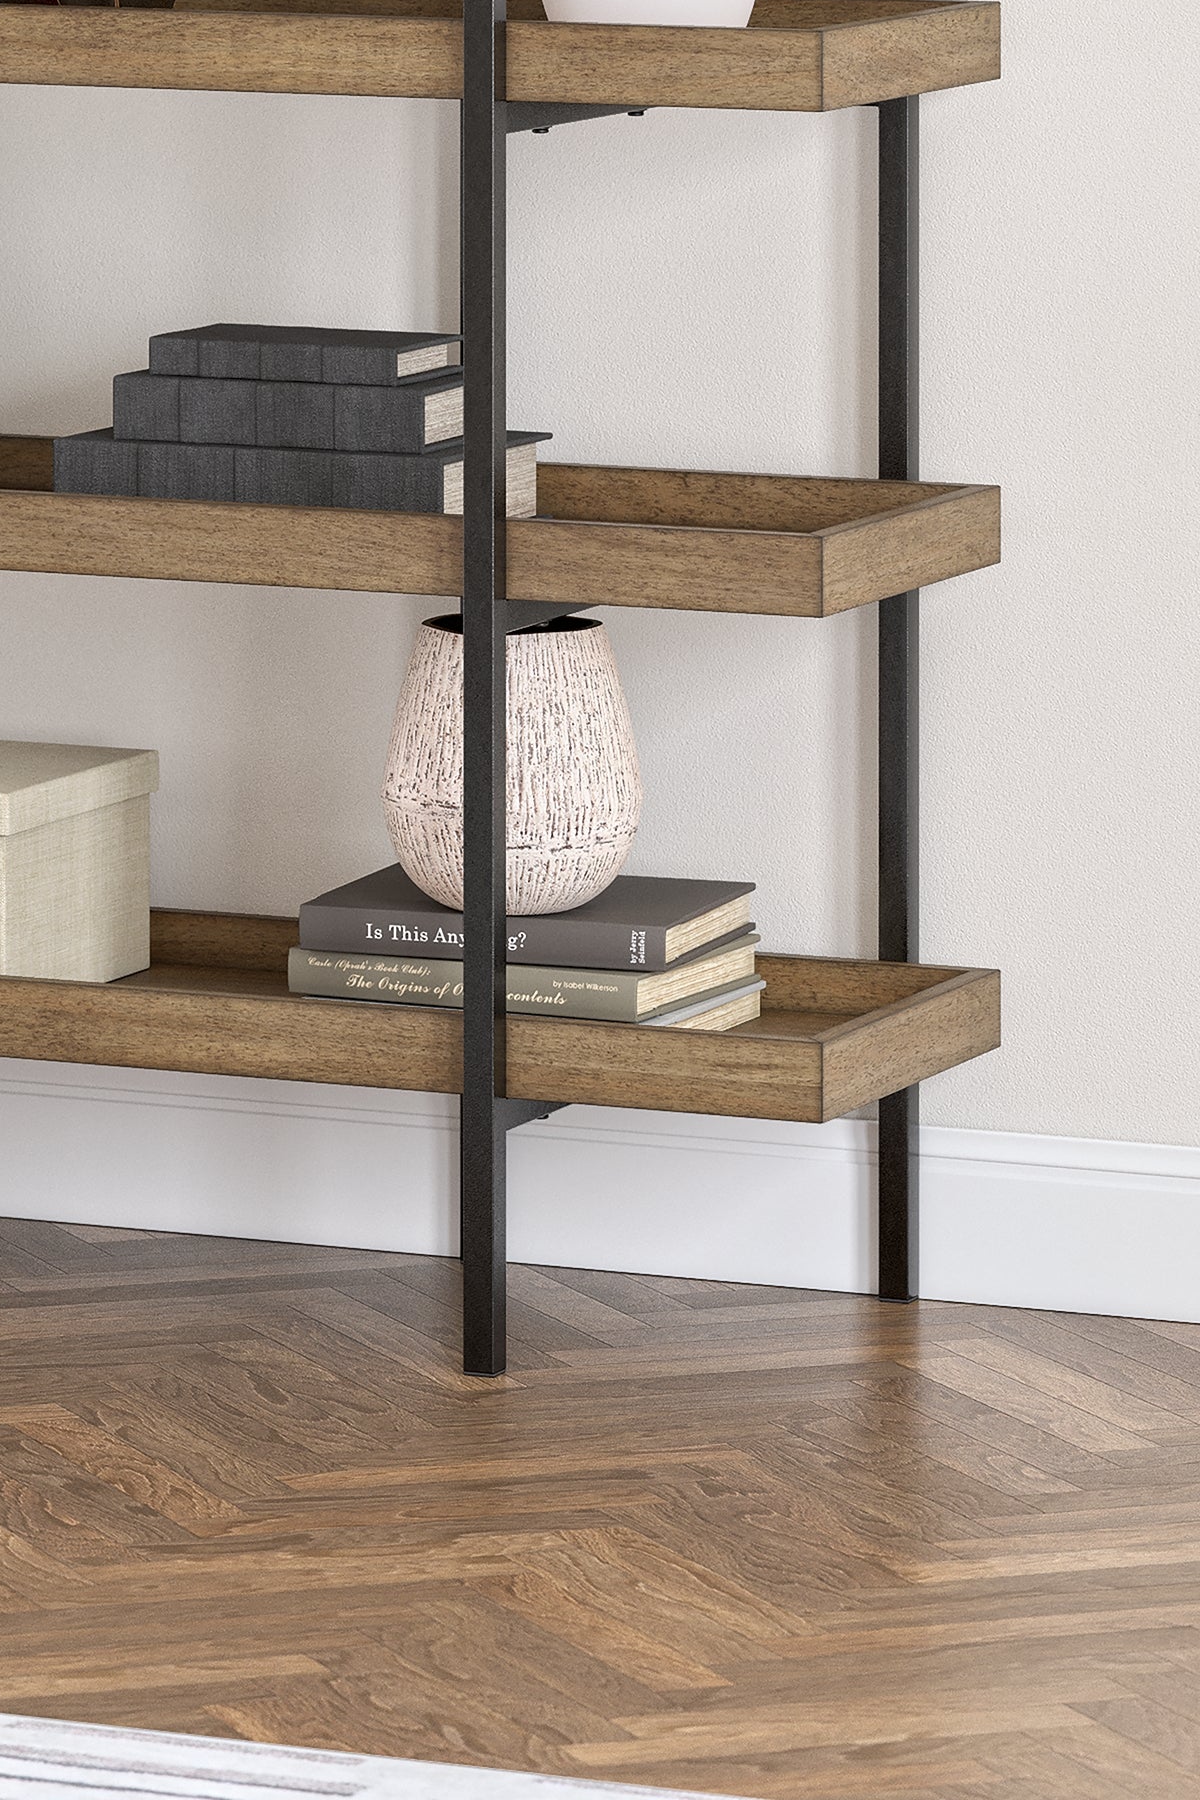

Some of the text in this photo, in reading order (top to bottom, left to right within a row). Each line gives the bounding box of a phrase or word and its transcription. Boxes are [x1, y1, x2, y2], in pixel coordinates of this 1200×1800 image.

[365, 922, 383, 940] Is
[388, 924, 429, 943] This
[629, 930, 639, 964] by Jerry
[374, 961, 400, 973] Book
[345, 973, 374, 988] The
[378, 976, 431, 997] Origins
[433, 982, 450, 999] of
[552, 979, 619, 993] by Isabel Wilkerson
